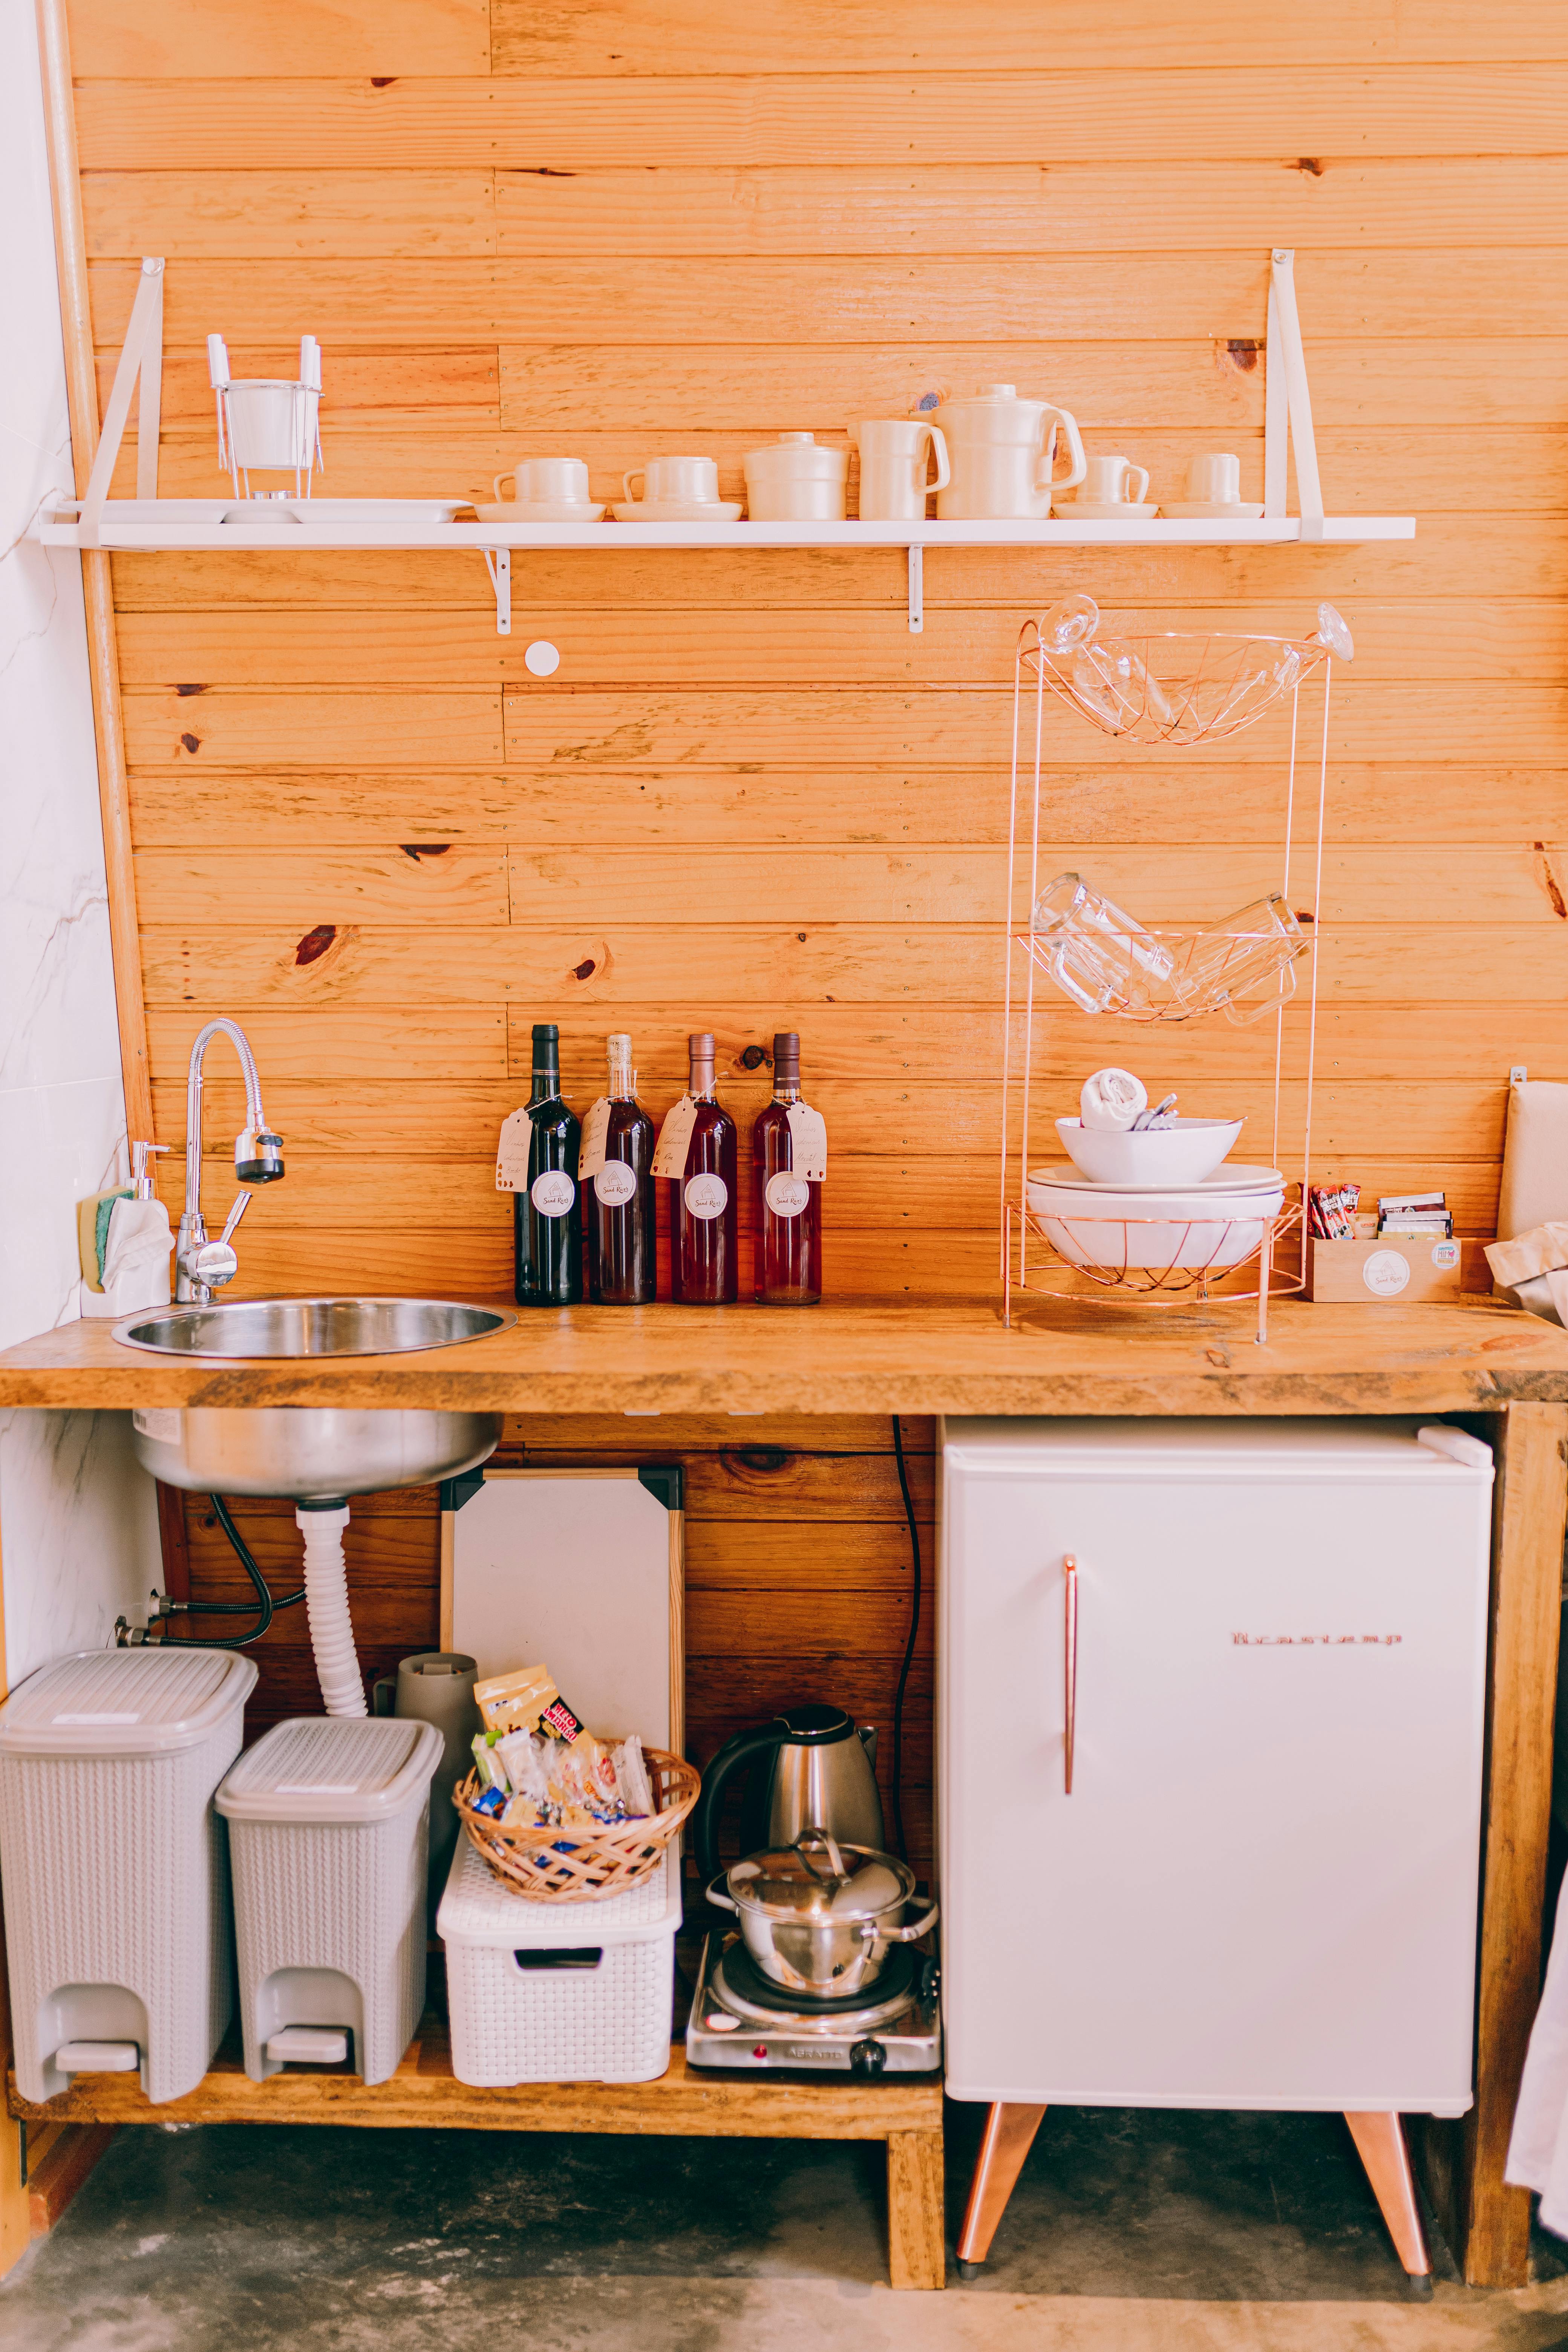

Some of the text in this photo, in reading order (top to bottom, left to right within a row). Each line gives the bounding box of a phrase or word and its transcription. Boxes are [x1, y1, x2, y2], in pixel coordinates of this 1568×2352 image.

[1232, 1632, 1402, 1645] Brastemp
[542, 1706, 578, 1744] AMARGO
[552, 1703, 577, 1729] MEIO
